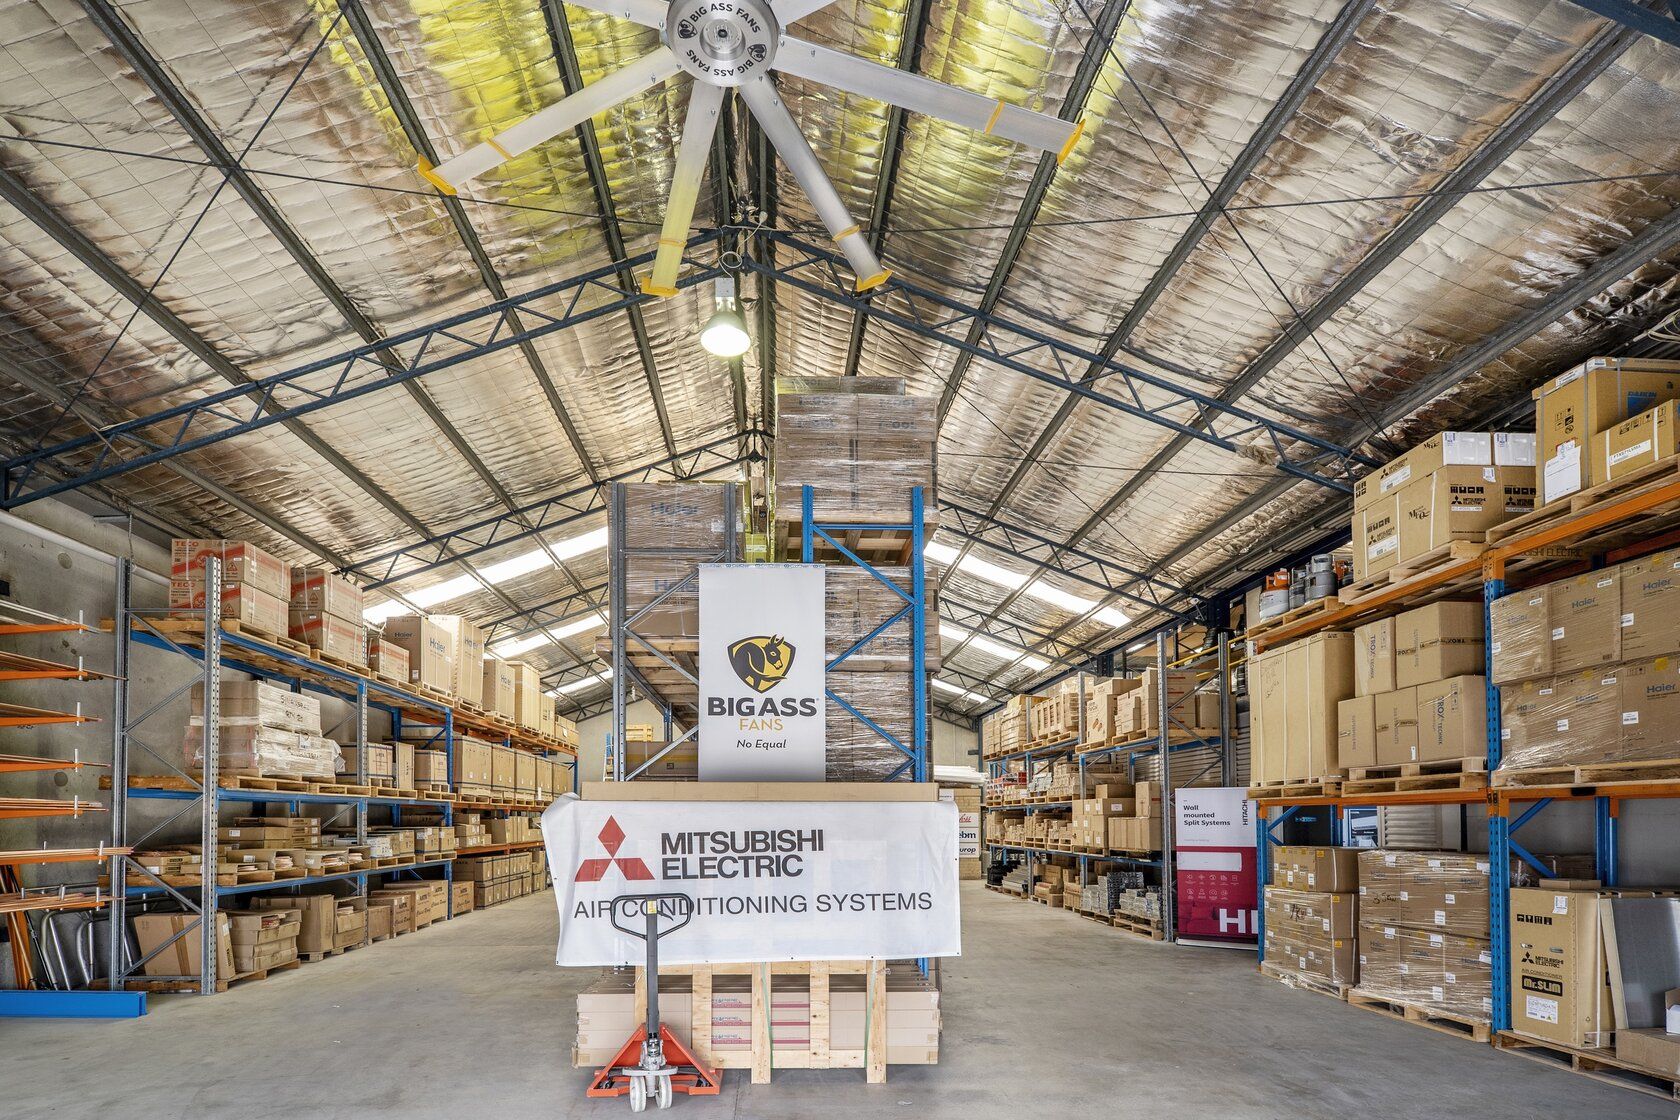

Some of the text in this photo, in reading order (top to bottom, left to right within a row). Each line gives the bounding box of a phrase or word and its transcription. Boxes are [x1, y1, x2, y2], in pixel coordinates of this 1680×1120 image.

[690, 3, 762, 34] BIG ASS FANS
[686, 49, 754, 76] BIG ASS FANS
[1643, 578, 1672, 590] Haier
[1572, 597, 1595, 608] Haier
[430, 638, 446, 653] Haier
[1646, 684, 1676, 694] Haier
[707, 697, 817, 717] BIG ASS
[739, 718, 784, 731] FANS
[736, 739, 786, 751] No Equal
[661, 829, 824, 855] MITSUBISHI
[662, 854, 804, 880] ELECTRIC
[816, 892, 932, 912] SYSTEMS
[1536, 956, 1564, 964] MITSUBISHI
